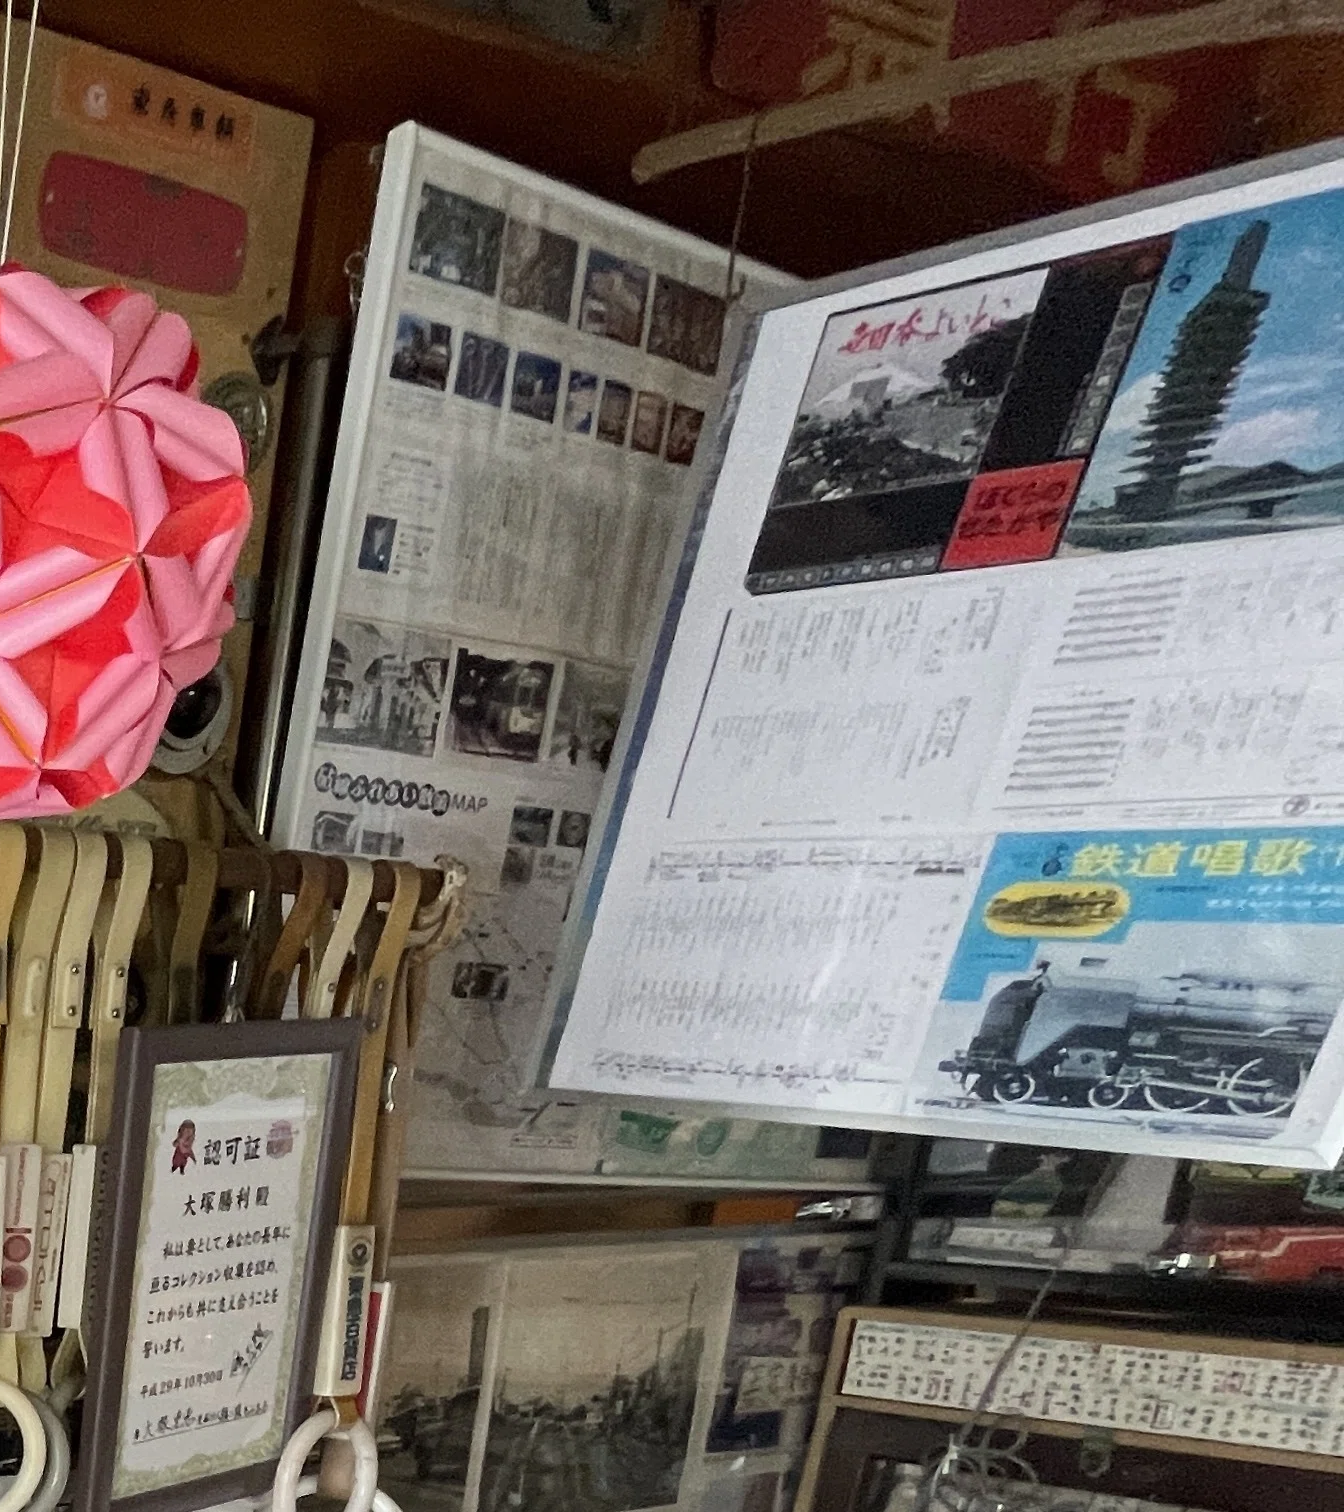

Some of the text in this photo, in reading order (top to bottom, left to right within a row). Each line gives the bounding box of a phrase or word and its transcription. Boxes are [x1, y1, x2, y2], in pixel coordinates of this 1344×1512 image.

[450, 793, 489, 814] MAP
[1069, 838, 1316, 878] 鉄道唱歌
[203, 1135, 262, 1166] 認可証
